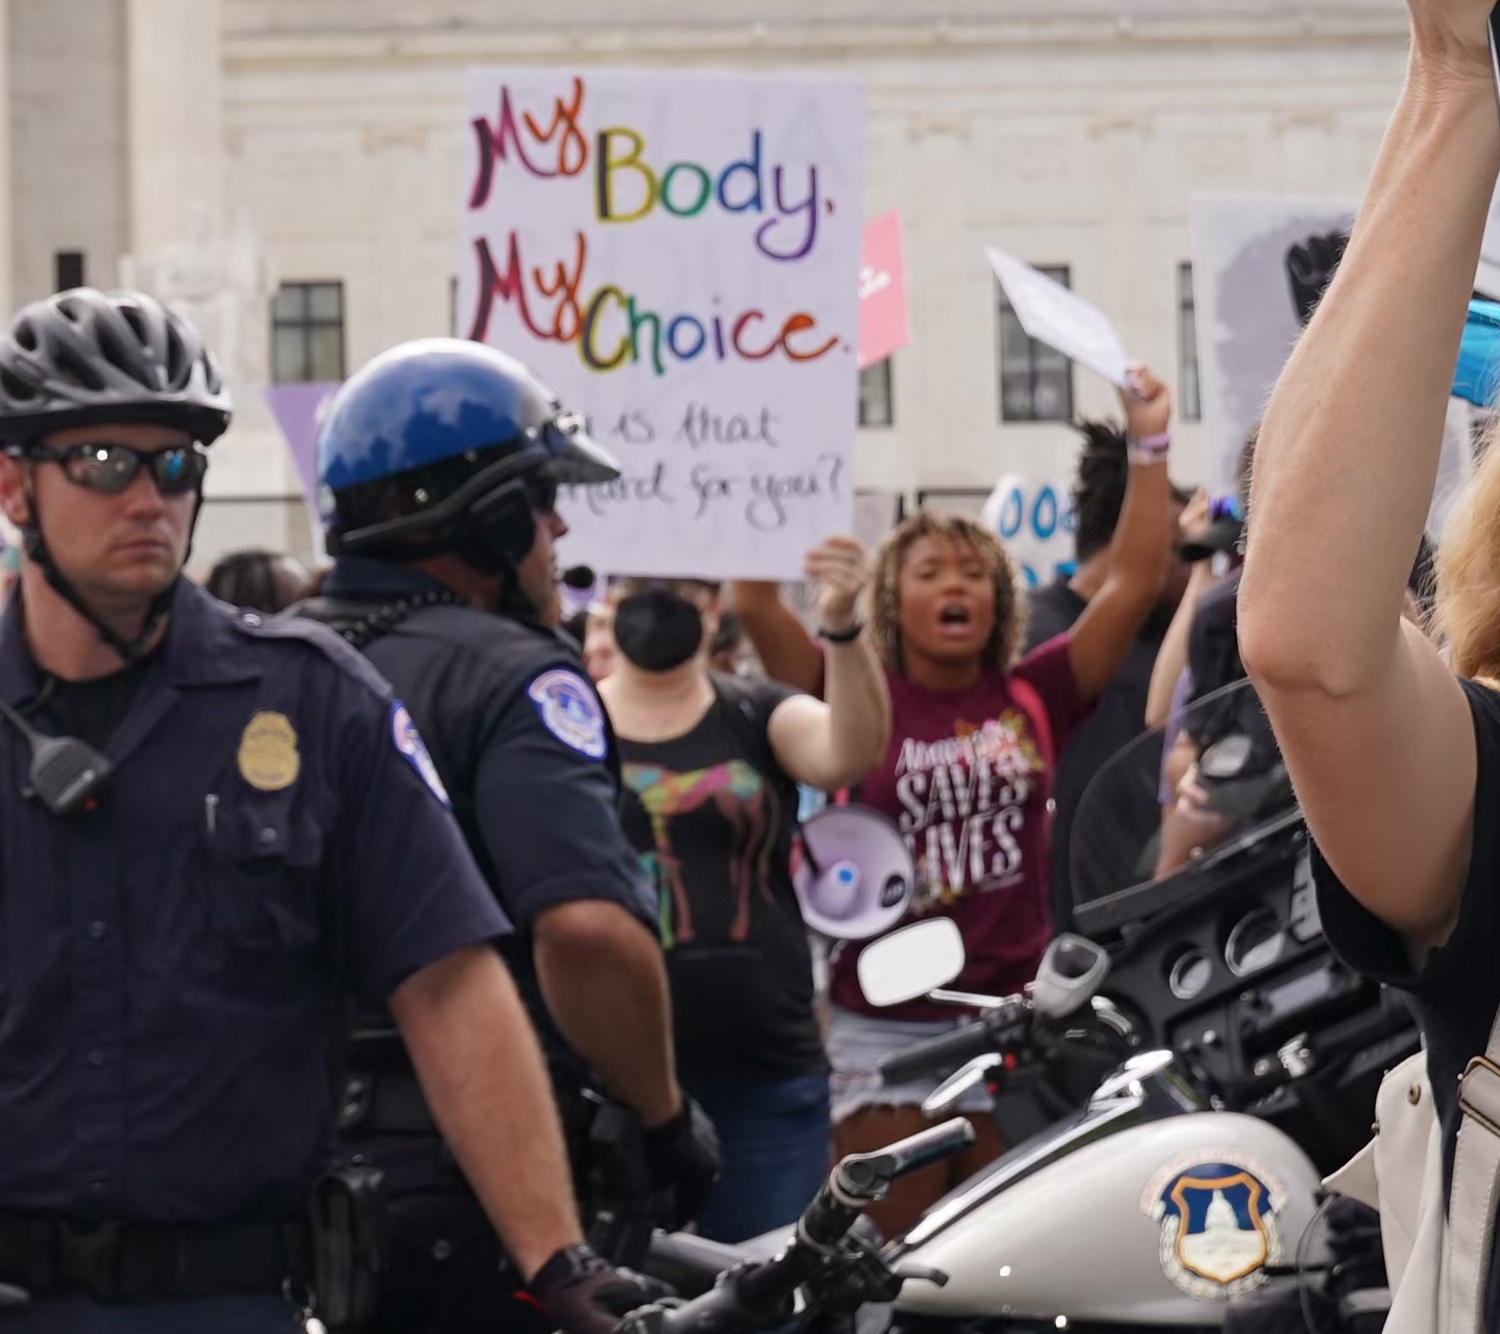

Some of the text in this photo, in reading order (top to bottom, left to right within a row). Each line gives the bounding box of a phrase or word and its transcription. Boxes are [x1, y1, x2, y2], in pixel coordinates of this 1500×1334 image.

[468, 76, 588, 210] My
[468, 231, 587, 342] My
[673, 402, 782, 448] that
